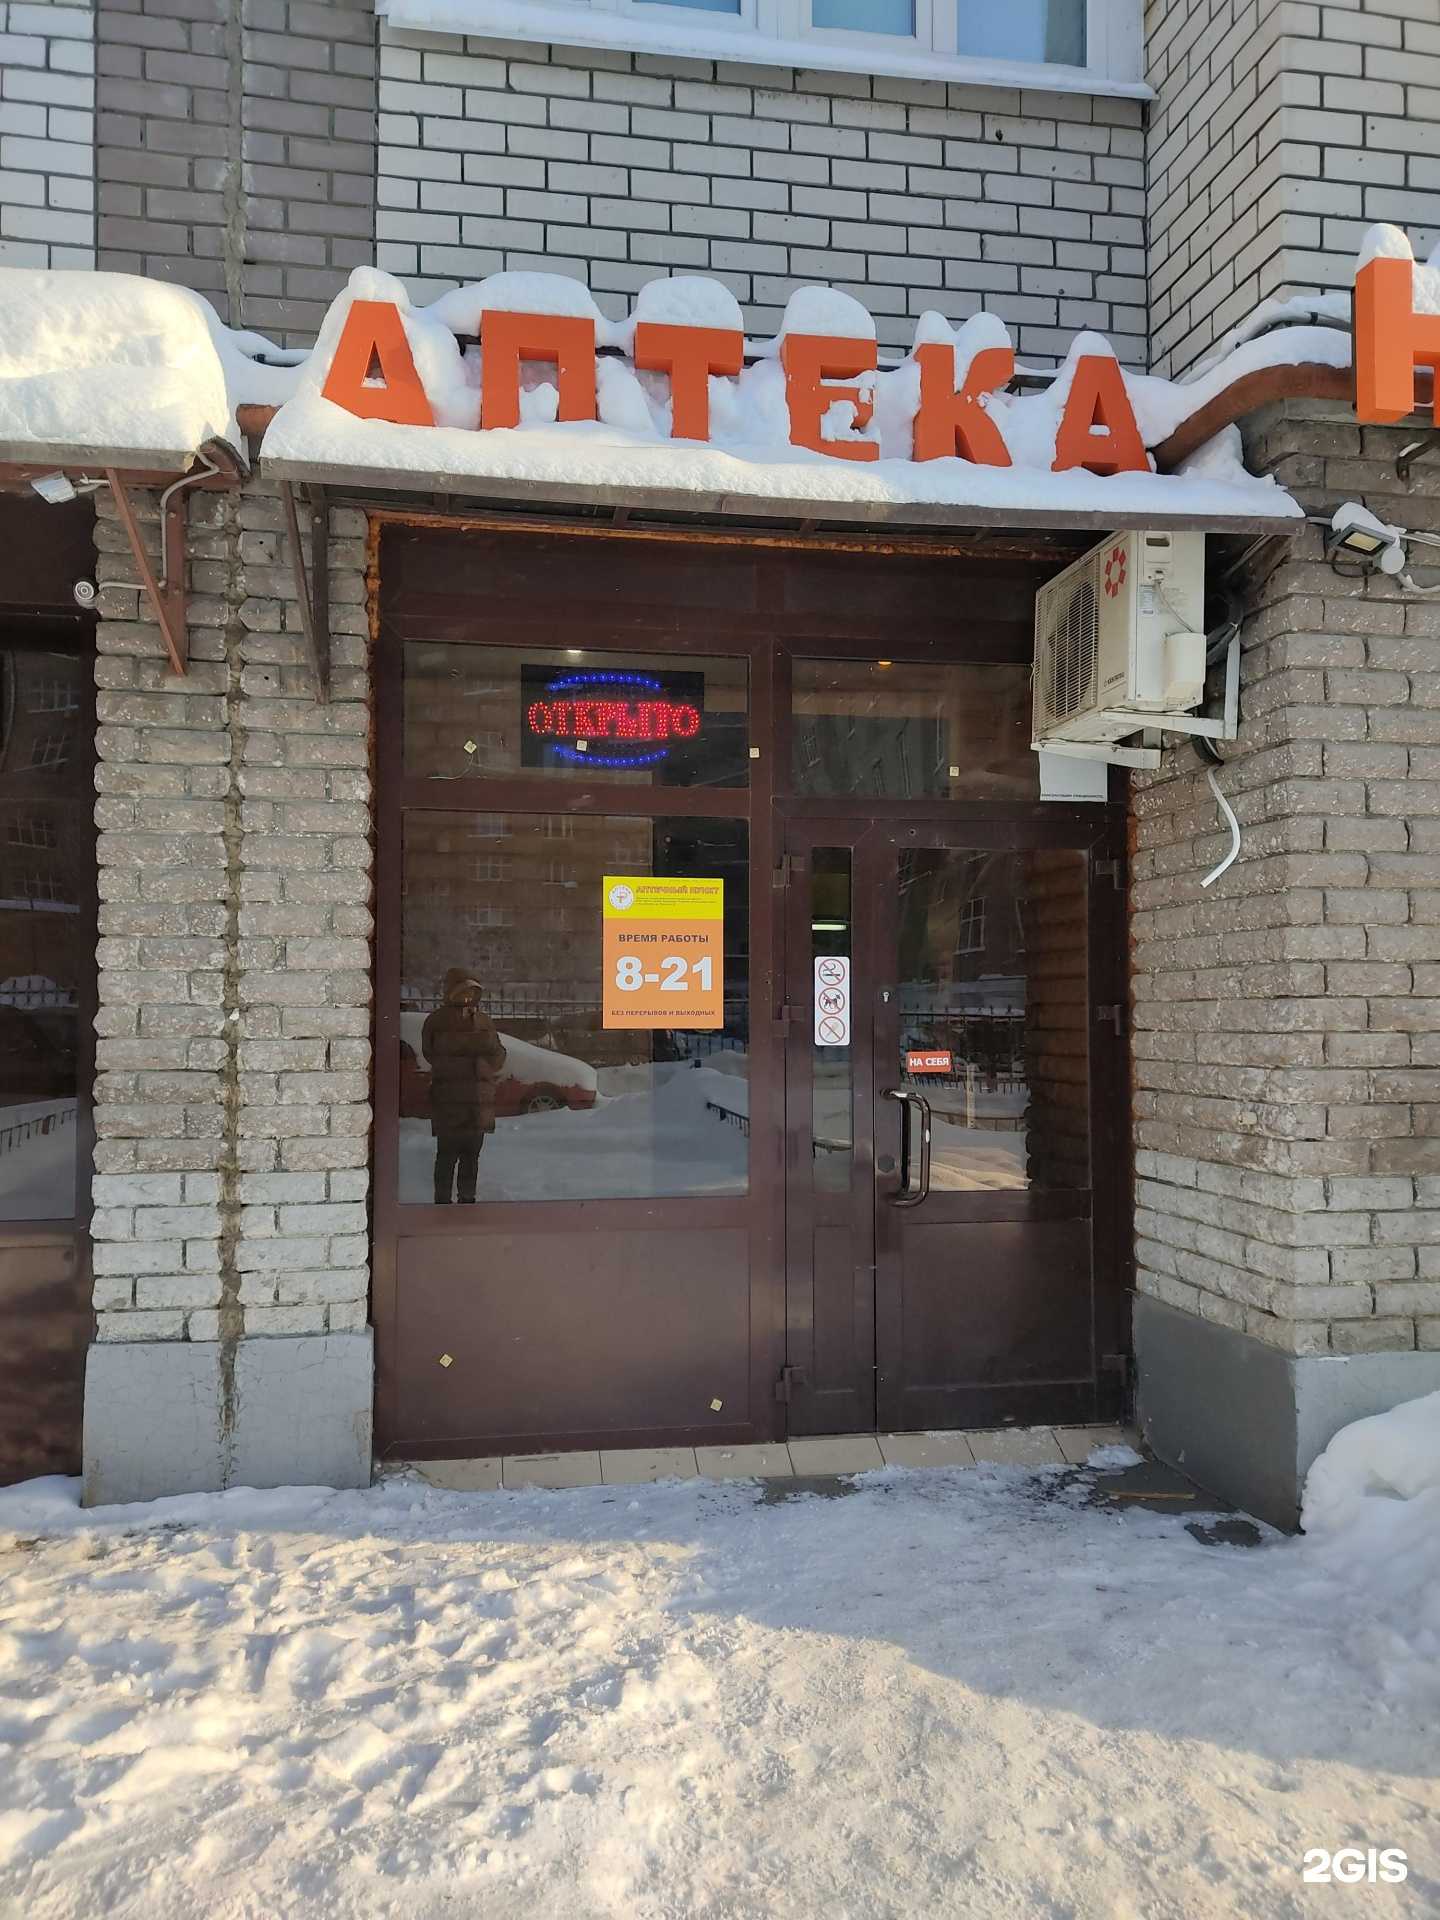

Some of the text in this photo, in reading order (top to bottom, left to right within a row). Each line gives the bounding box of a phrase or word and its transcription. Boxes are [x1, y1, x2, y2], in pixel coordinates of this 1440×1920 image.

[321, 299, 1151, 475] АПТЕКА
[527, 701, 701, 737] ОТКРЫТО
[618, 934, 709, 943] ВРЕМЯ РАБОТЫ
[615, 955, 713, 992] 8-21
[675, 1009, 715, 1017] ВЫХОДНЫХ
[909, 1056, 950, 1067] НА СЕБЯ
